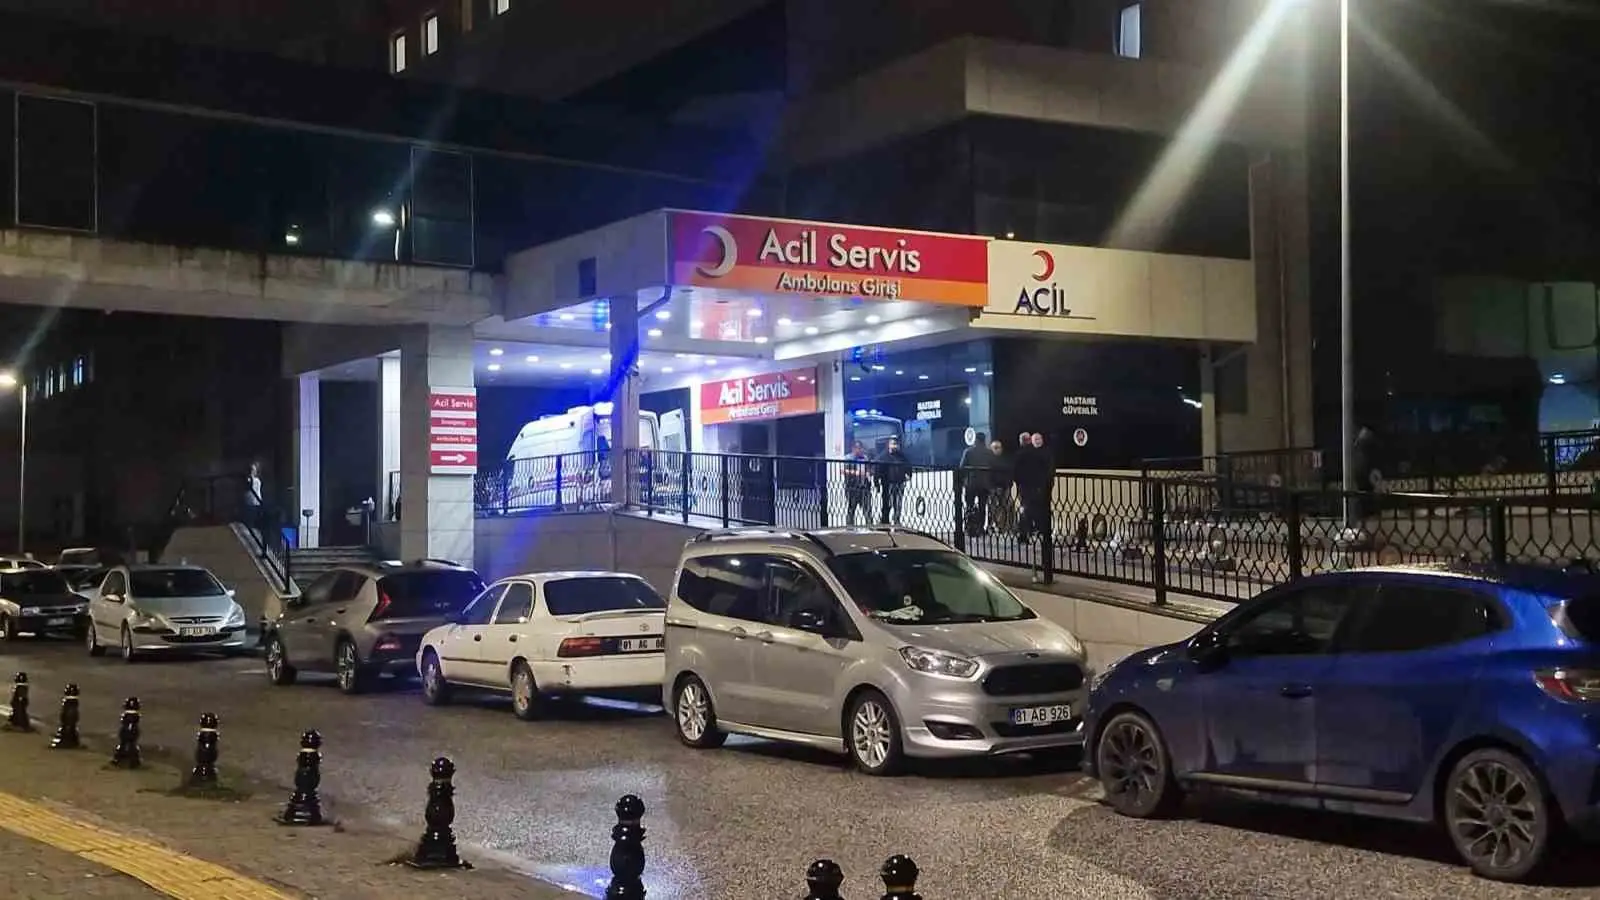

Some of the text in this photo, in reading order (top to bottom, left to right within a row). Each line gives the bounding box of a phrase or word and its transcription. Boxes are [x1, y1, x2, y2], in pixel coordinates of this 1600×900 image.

[760, 228, 921, 273] Acil Servis
[780, 271, 901, 298] Ambulans Girişi
[1014, 282, 1071, 316] ACİL
[719, 375, 790, 405] Acil Servis
[1063, 396, 1097, 405] HASTANE
[434, 398, 473, 409] Acil Servis
[1062, 405, 1099, 416] GÜVENLİK
[1016, 705, 1069, 721] 81 AB 926
